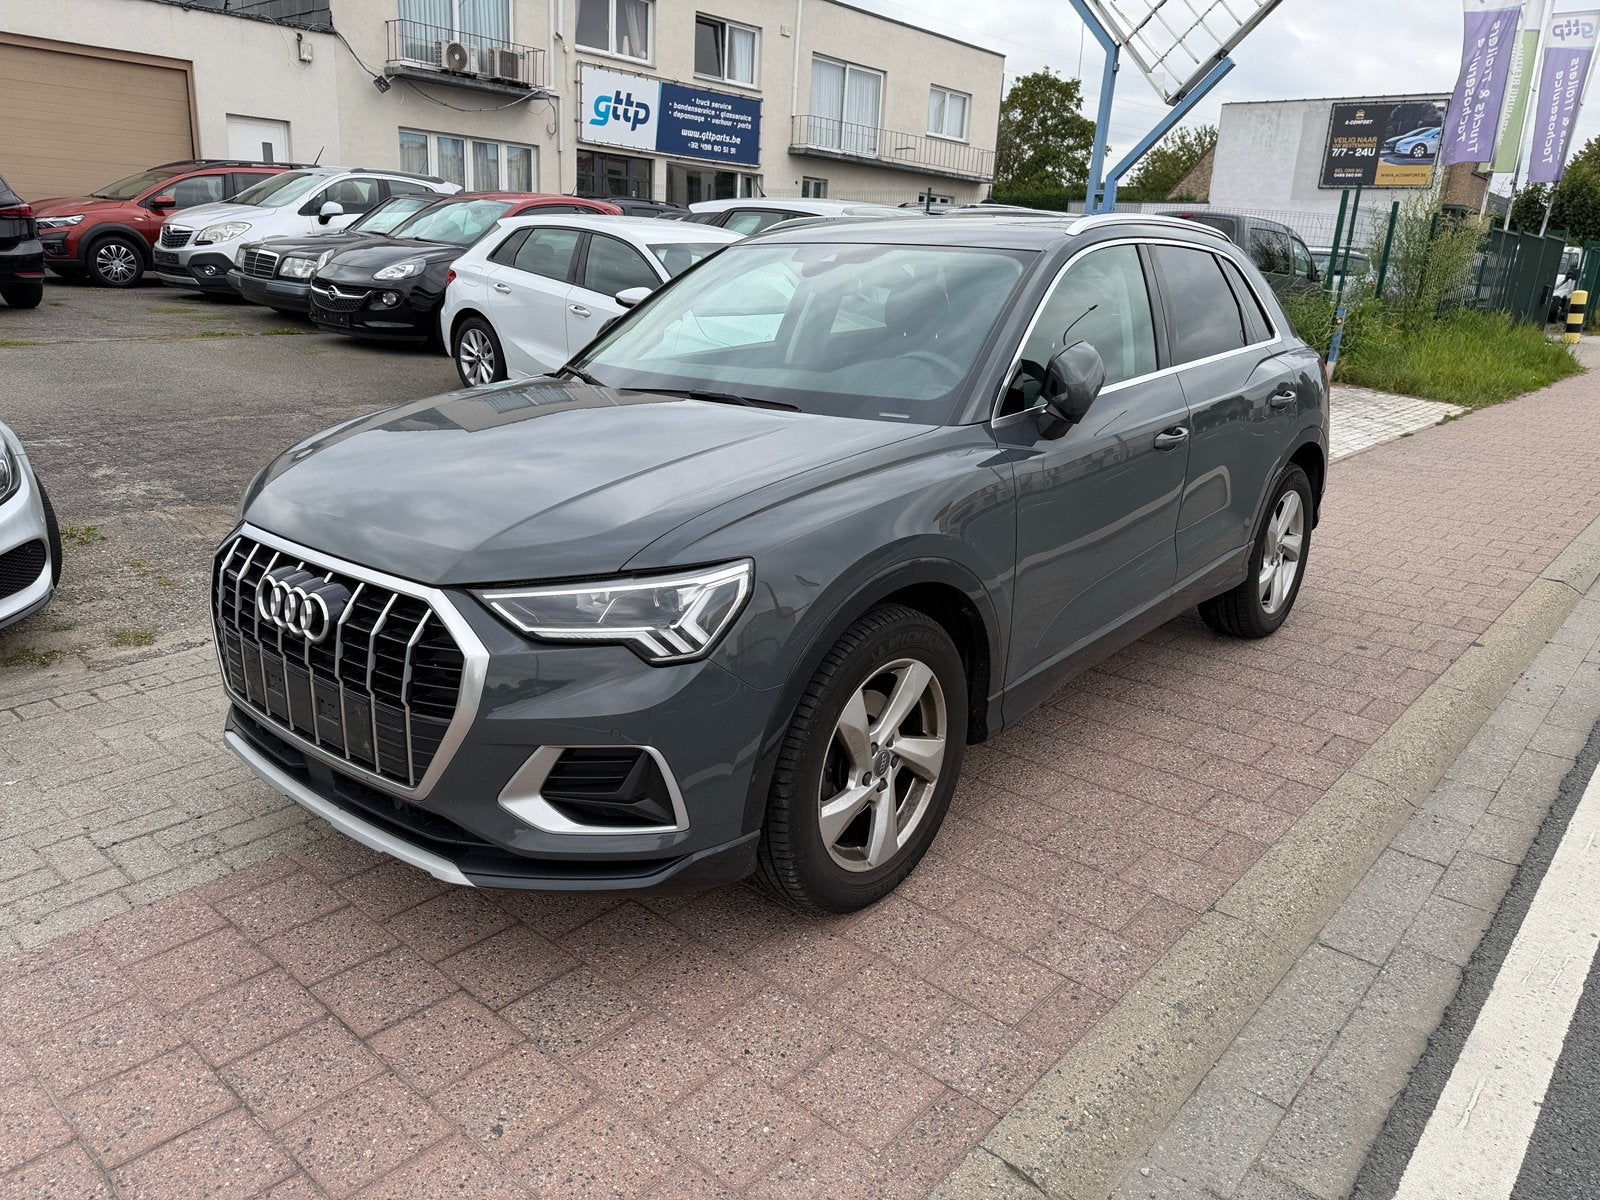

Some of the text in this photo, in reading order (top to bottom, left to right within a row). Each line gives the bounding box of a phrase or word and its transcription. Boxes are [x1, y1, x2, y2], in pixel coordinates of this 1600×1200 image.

[589, 90, 650, 131] gttp
[673, 101, 752, 121] bandenservice glasservice
[695, 97, 732, 110] truck service
[673, 110, 752, 130] depannage verhuur parts
[681, 128, 741, 145] www.gttparts.be
[687, 141, 699, 149] +32
[1331, 148, 1347, 157] 7/7
[1355, 147, 1376, 157] 24U
